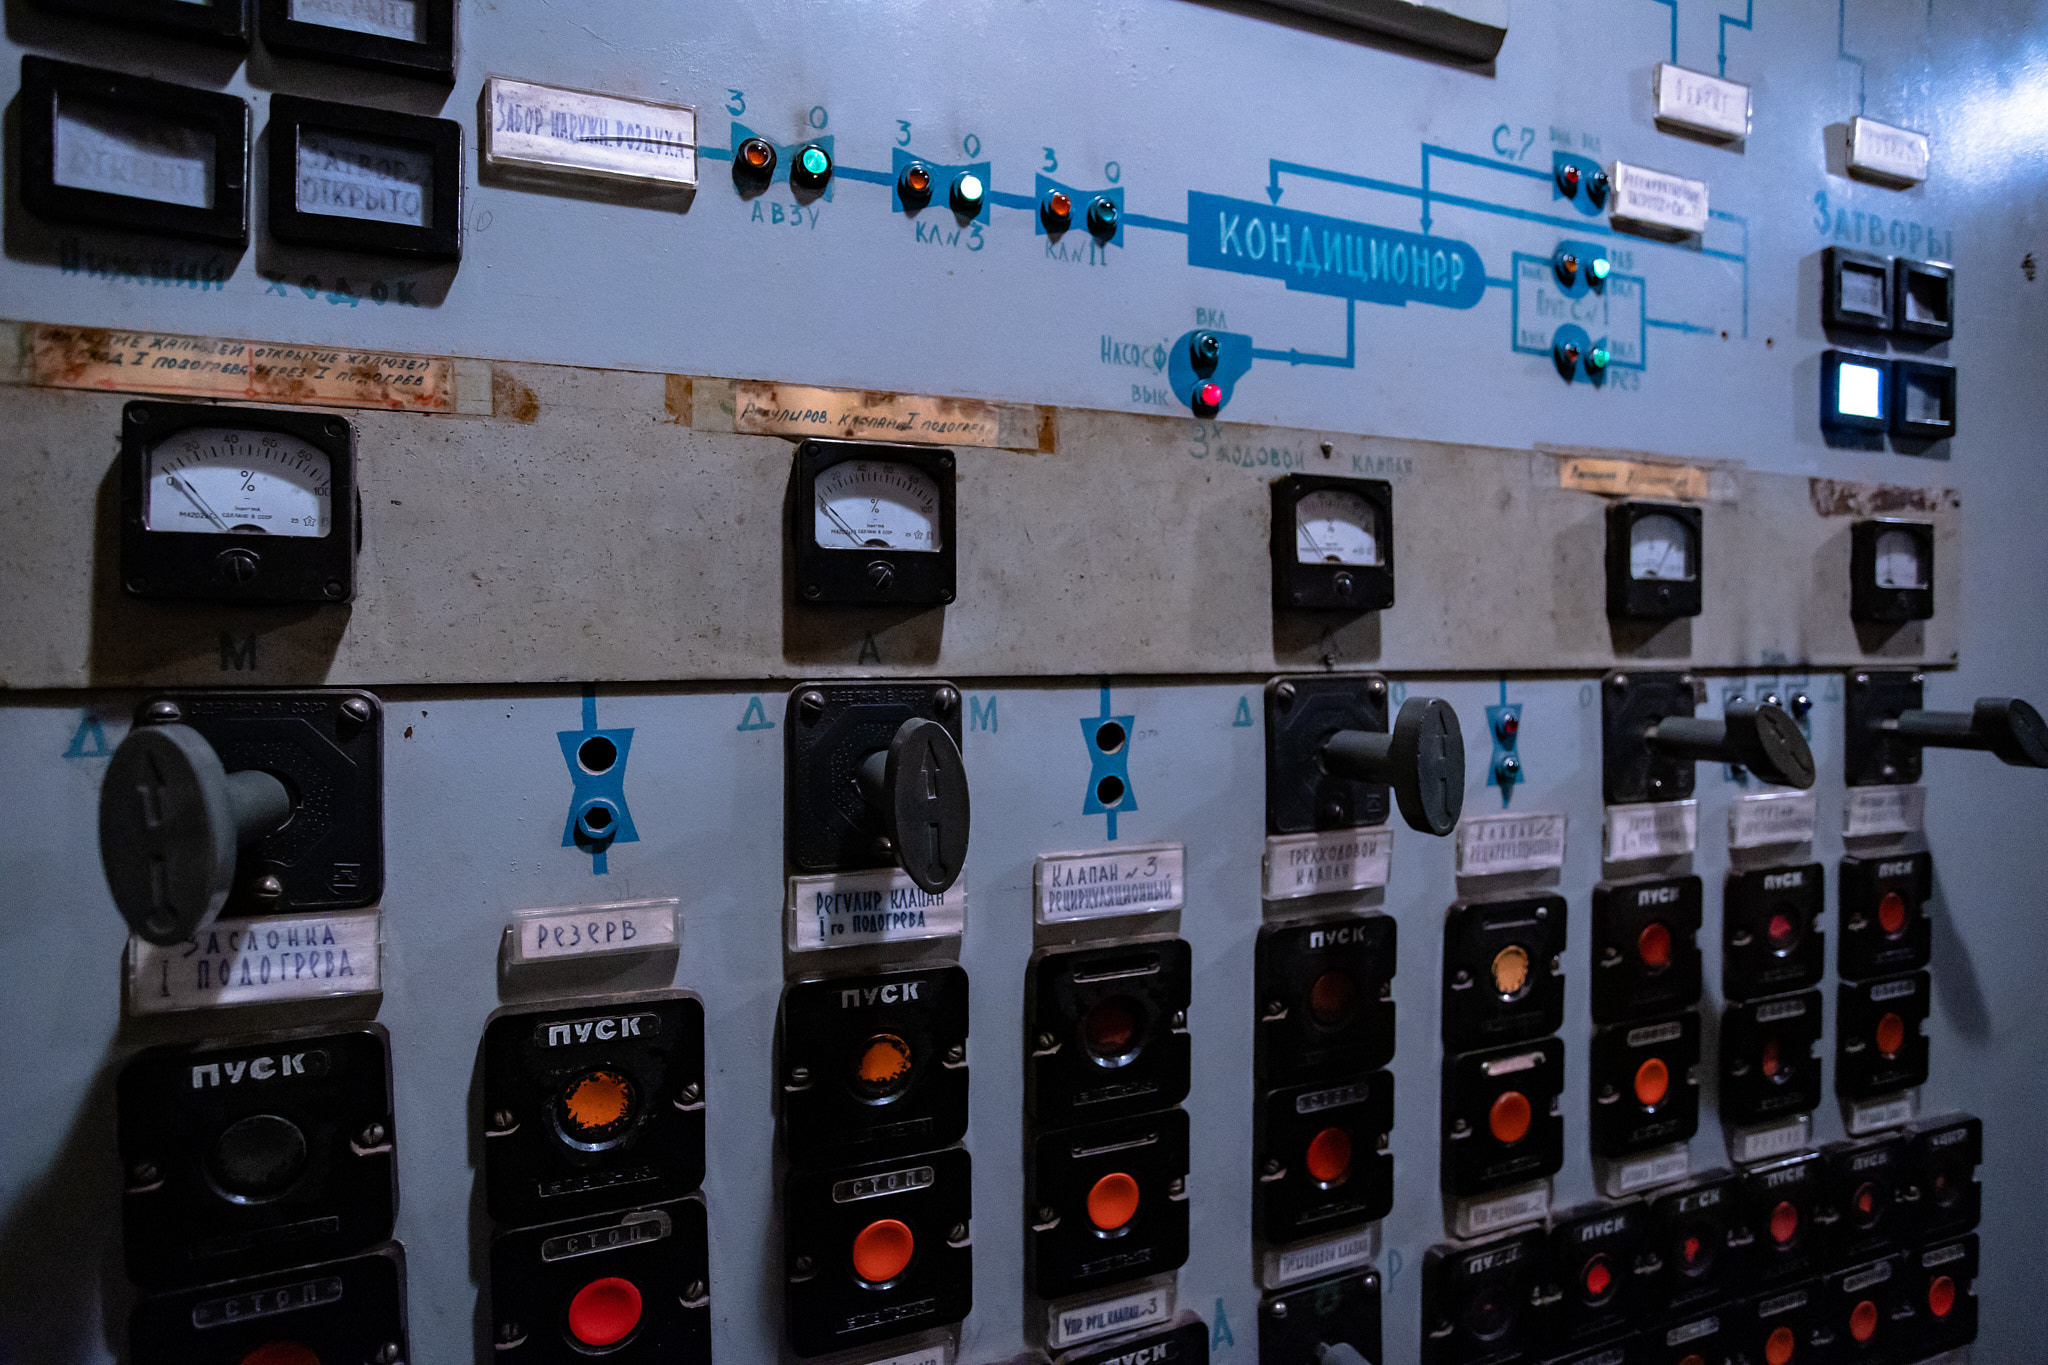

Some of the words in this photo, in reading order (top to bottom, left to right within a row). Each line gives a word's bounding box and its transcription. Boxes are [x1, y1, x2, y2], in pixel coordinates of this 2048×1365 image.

[1052, 863, 1118, 888] КЛАПАН
[1310, 927, 1366, 948] ПУСК
[841, 982, 920, 1009] ПУСК
[548, 1016, 641, 1047] ПУСК
[191, 1052, 306, 1089] ПУСК
